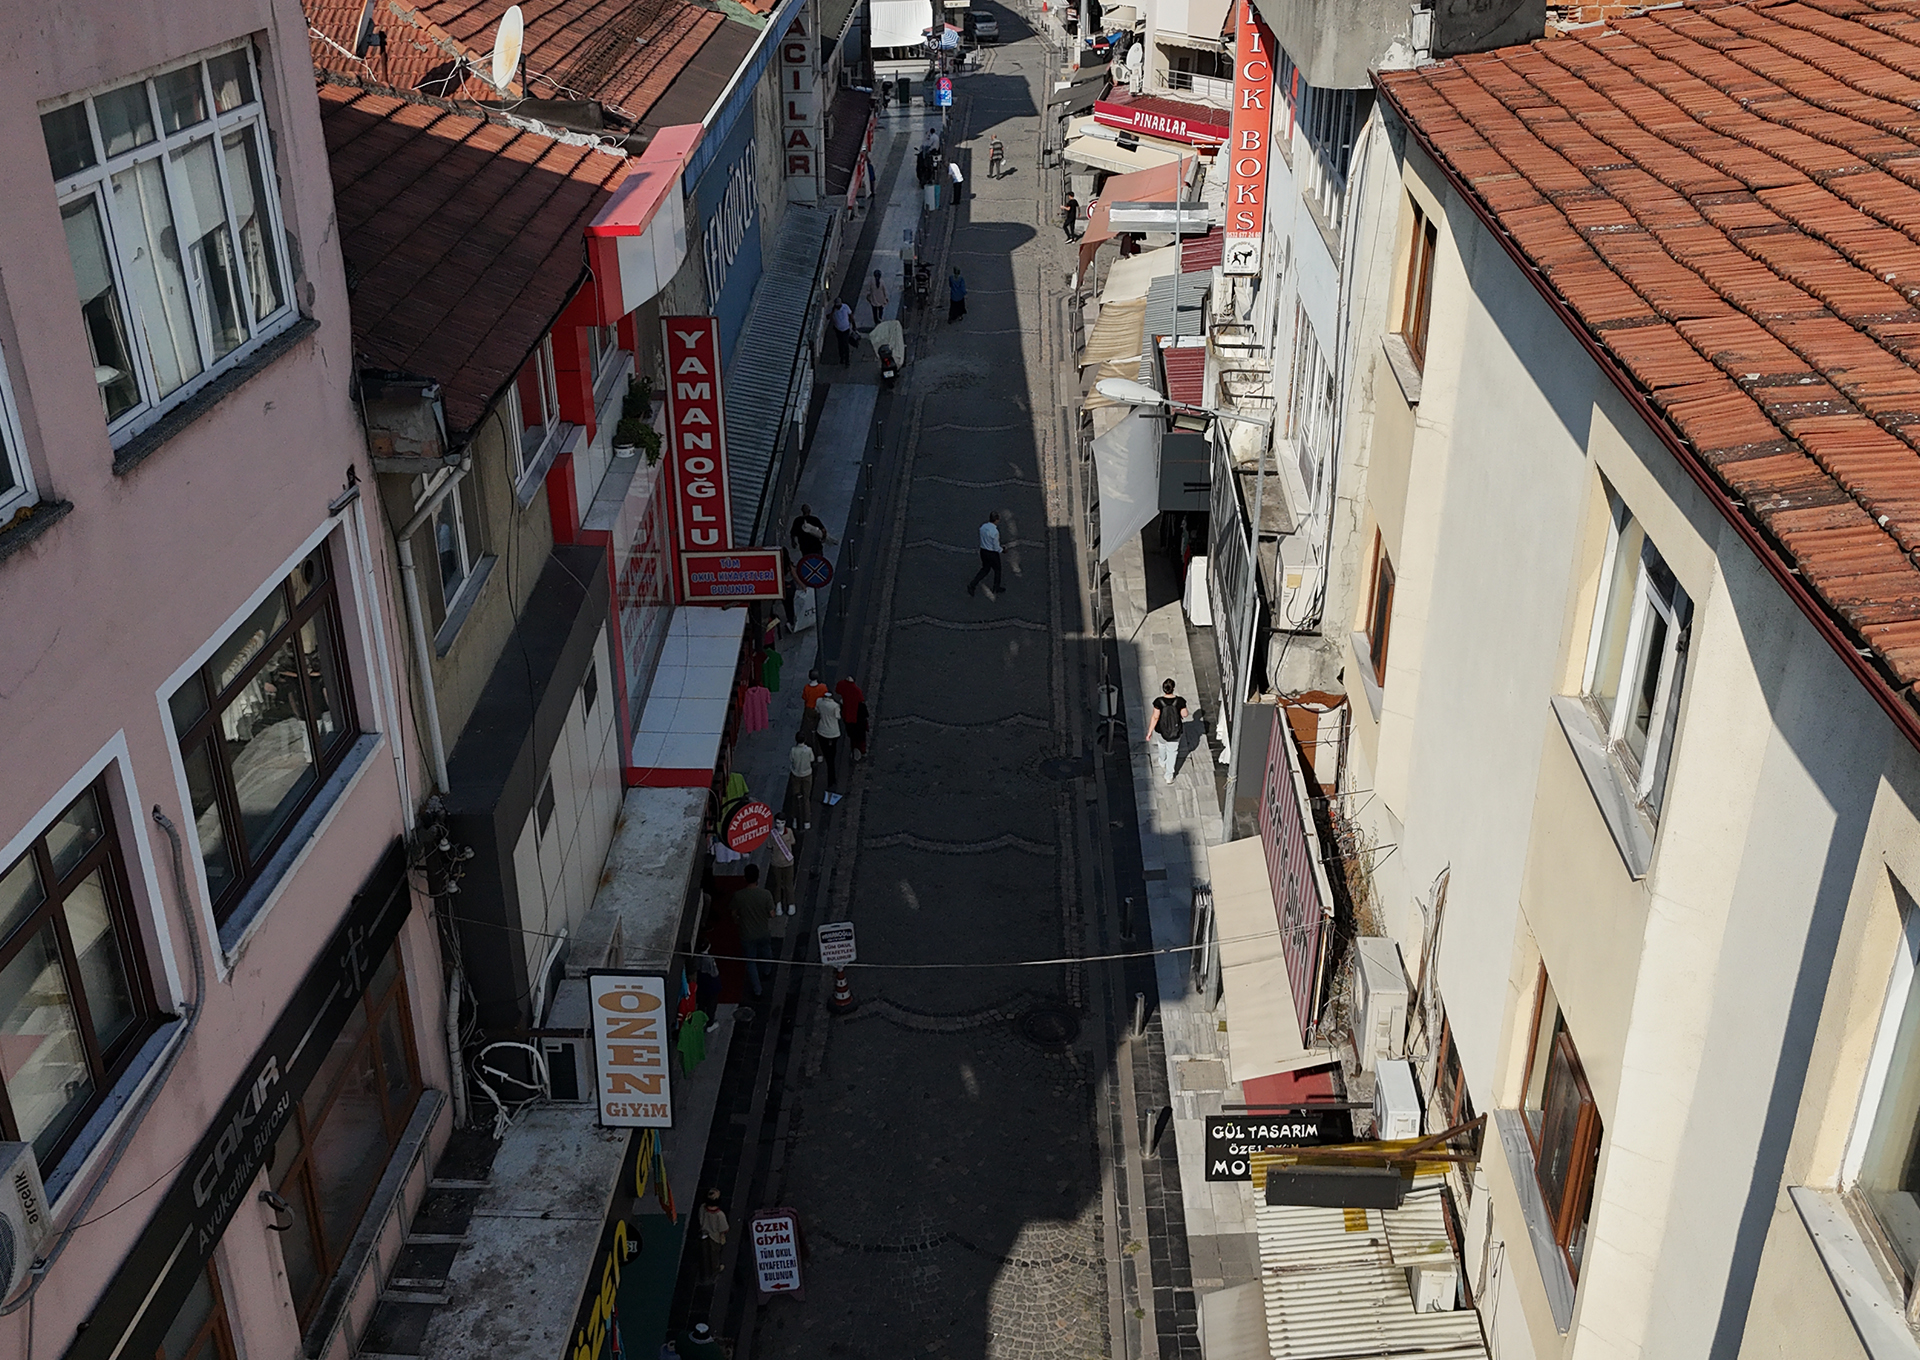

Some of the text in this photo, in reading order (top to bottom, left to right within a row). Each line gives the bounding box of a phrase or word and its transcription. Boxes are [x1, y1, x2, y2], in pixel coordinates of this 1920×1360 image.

[784, 8, 811, 175] ACILAR
[1133, 111, 1187, 137] PINARLAR
[1235, 129, 1263, 231] BOKS
[674, 330, 719, 545] YAMANOĞLU
[691, 568, 774, 583] OKUL KIYAFETLERİ
[720, 557, 740, 569] TÜM
[710, 584, 755, 595] BULUNUR
[729, 803, 772, 832] YAMANOĞLU
[598, 985, 667, 1096] ÖZEN
[192, 1055, 280, 1209] ÇAKIR
[1211, 1122, 1318, 1140] GÜL TASARIM
[198, 1090, 290, 1255] Avukatlık Bürosu
[15, 1170, 39, 1225] arçelik
[755, 1222, 788, 1233] ÖZEN
[758, 1257, 797, 1271] KIYAFETLERİ
[760, 1248, 792, 1259] TÜM OKUL
[764, 1270, 794, 1281] BULUNUR
